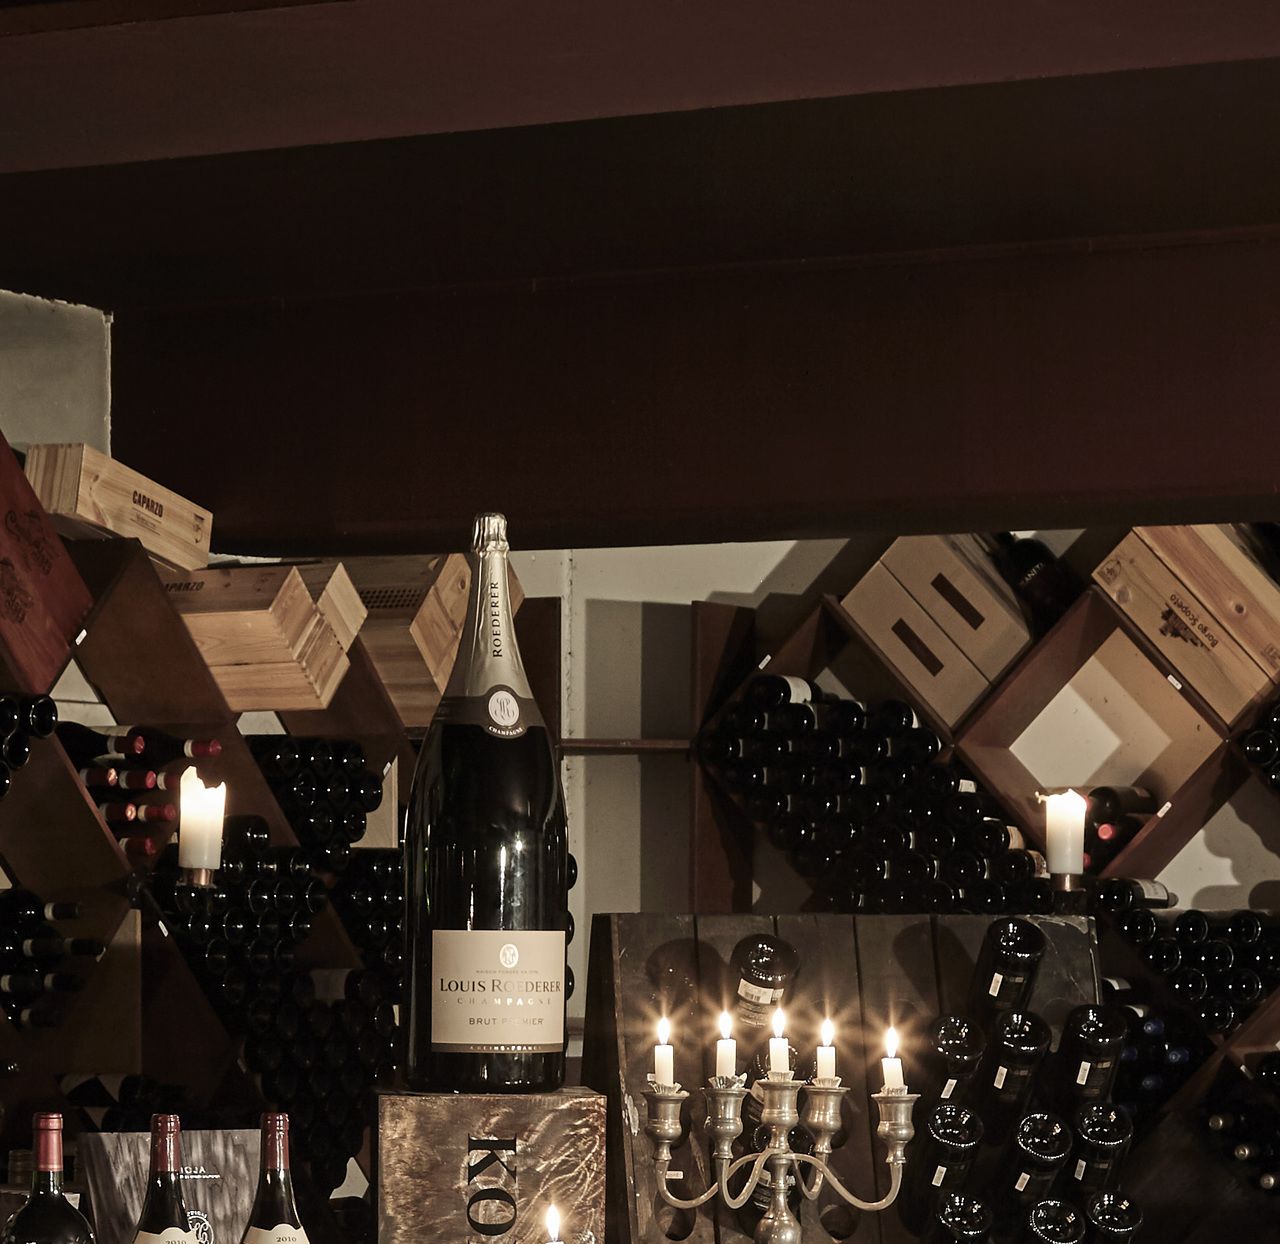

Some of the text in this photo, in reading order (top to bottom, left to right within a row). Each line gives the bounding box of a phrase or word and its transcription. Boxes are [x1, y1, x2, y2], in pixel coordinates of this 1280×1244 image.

[132, 490, 164, 518] CAPARZO
[490, 581, 503, 658] ROEDERER
[1170, 594, 1219, 648] Borgo Scopeto
[440, 978, 561, 993] LOUIS ROEDERER
[469, 1017, 497, 1026] BRUT
